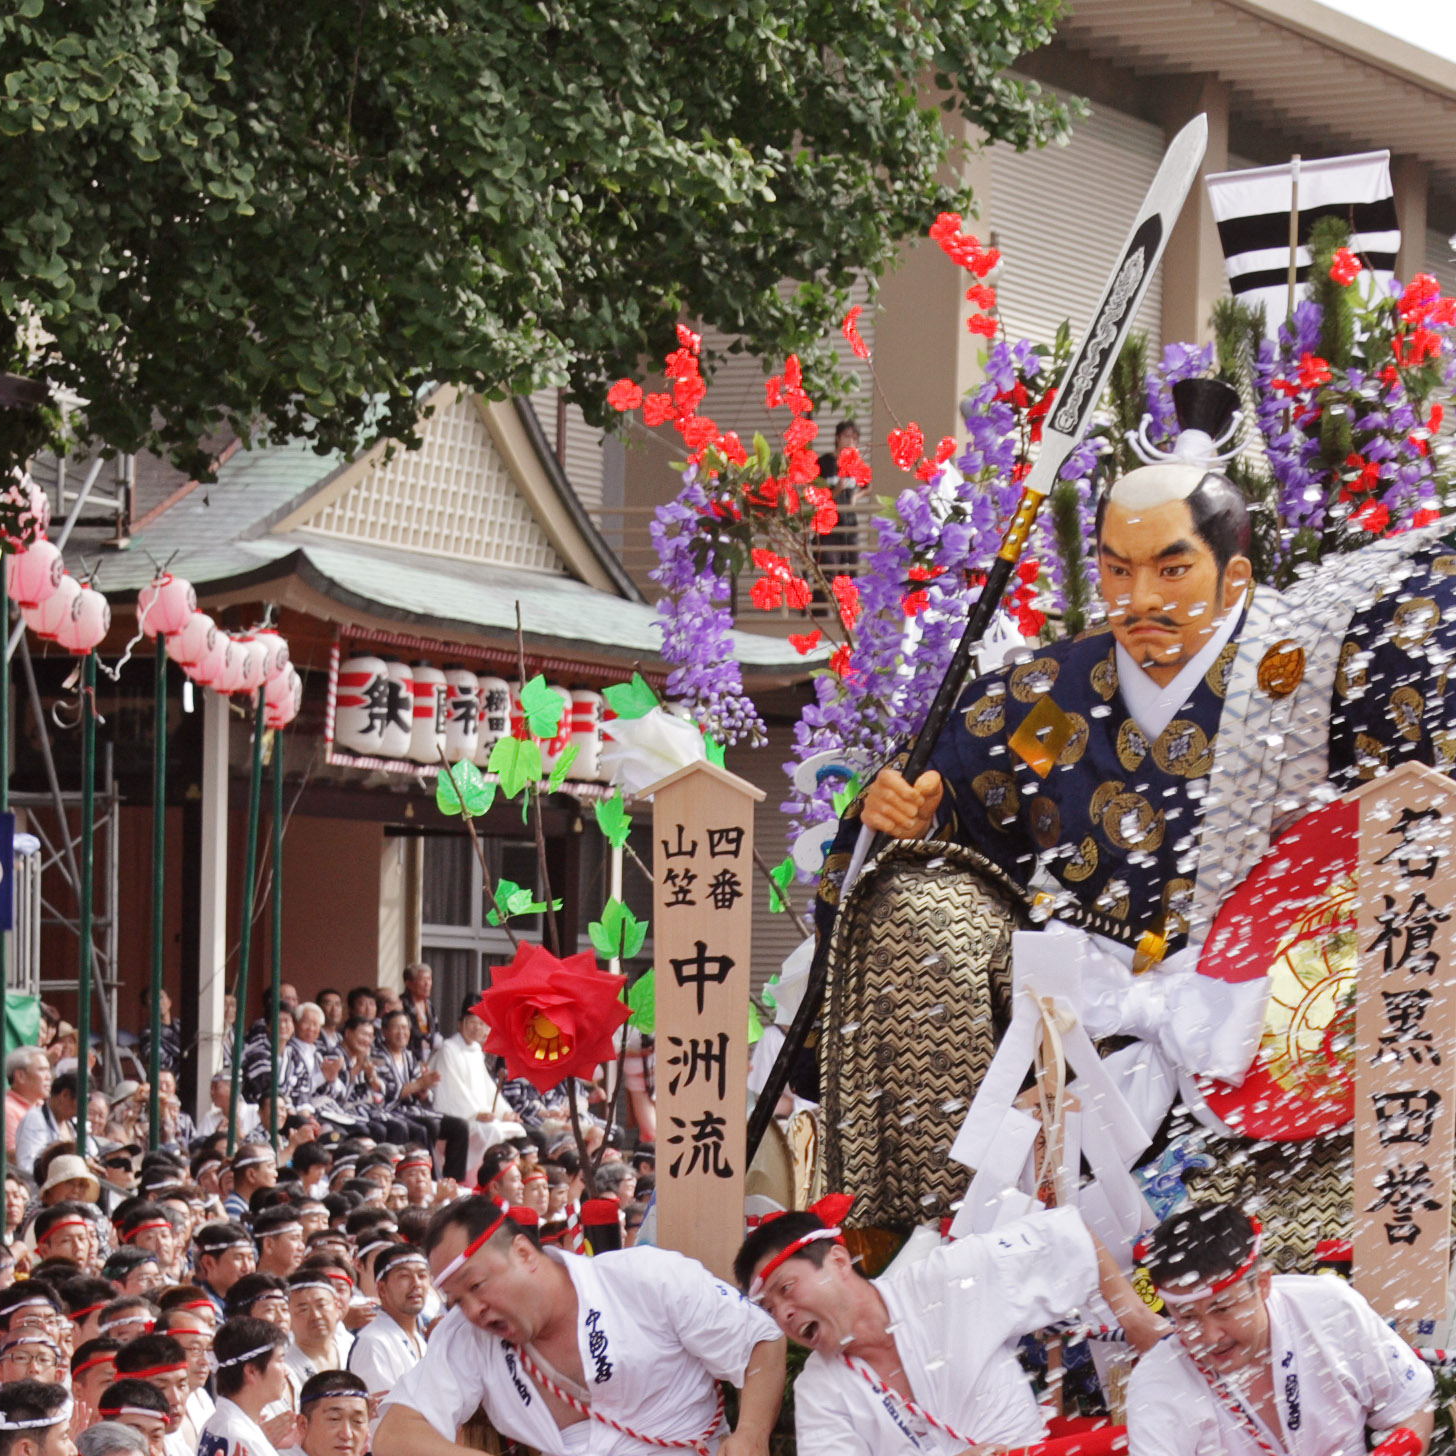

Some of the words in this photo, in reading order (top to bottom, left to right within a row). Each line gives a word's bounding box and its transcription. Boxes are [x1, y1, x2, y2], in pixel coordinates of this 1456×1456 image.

[661, 823, 698, 910] 山笠
[705, 825, 746, 911] 四番
[666, 941, 736, 1180] 中洲流
